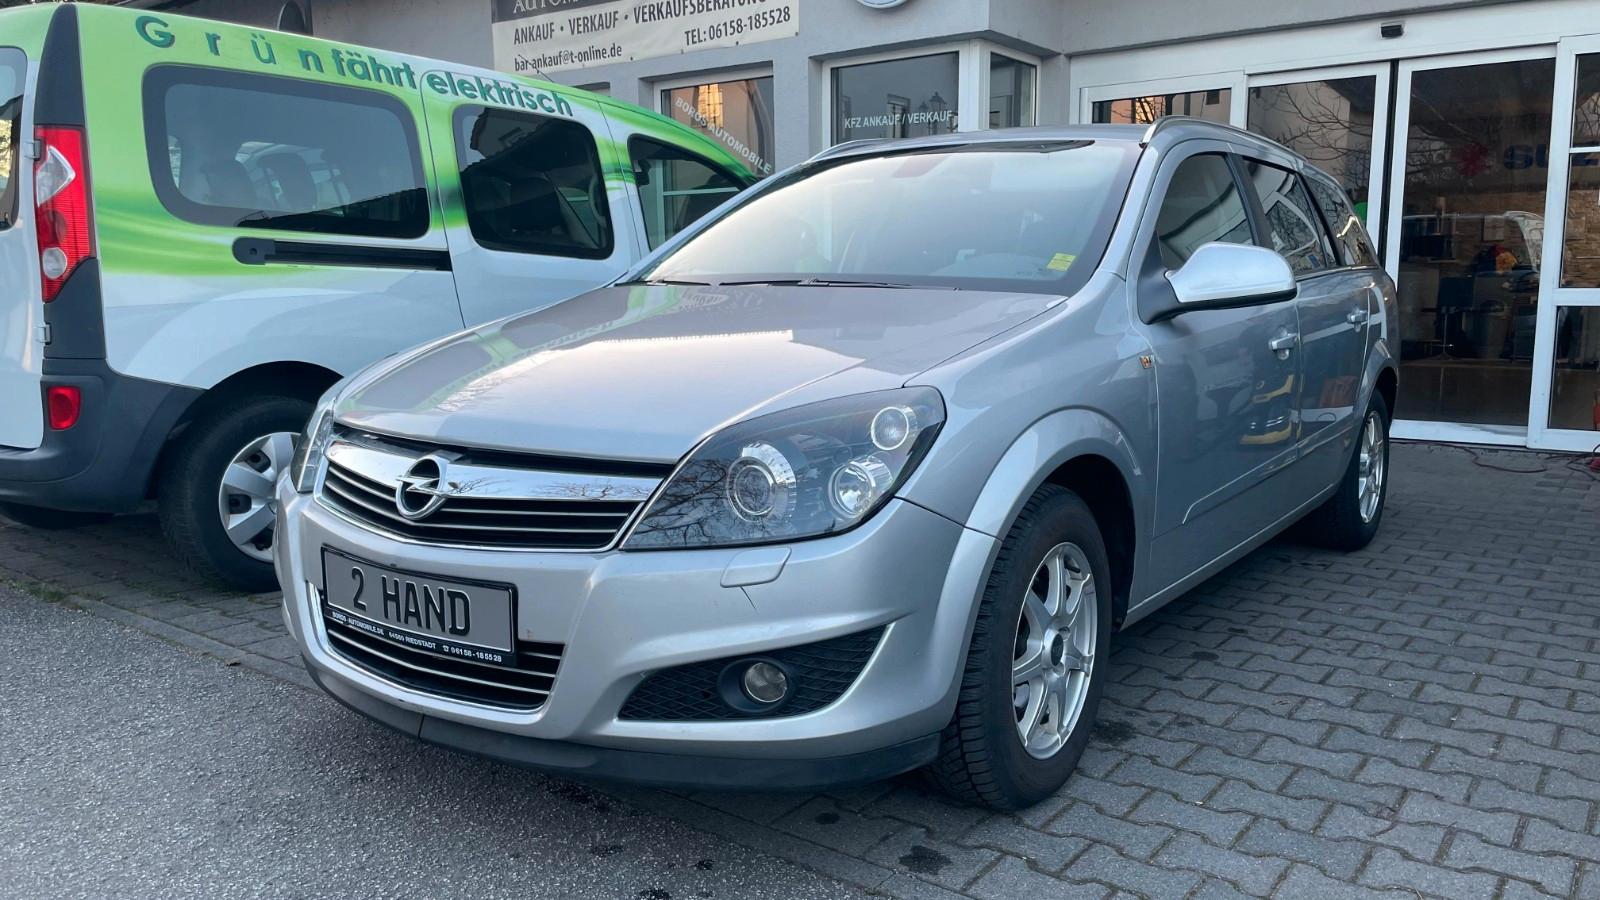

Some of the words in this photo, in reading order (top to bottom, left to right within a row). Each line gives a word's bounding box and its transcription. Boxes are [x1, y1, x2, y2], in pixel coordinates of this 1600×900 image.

[514, 22, 555, 45] ANKAUF
[568, 11, 619, 35] VERKAUF
[634, 0, 766, 24] VERKAUFSBERA
[709, 6, 790, 40] 06158-185528
[515, 43, 622, 71] bar-ankauf@t-online.de
[331, 48, 417, 89] fährt
[427, 71, 574, 117] elektrisch
[675, 97, 707, 127] BOROS
[708, 123, 772, 174] AUTOMOBILE
[844, 117, 861, 128] KFZ
[863, 113, 900, 127] ANKAUF
[907, 110, 953, 124] VERKAUF
[352, 566, 367, 612] 2
[381, 575, 471, 636] HAND
